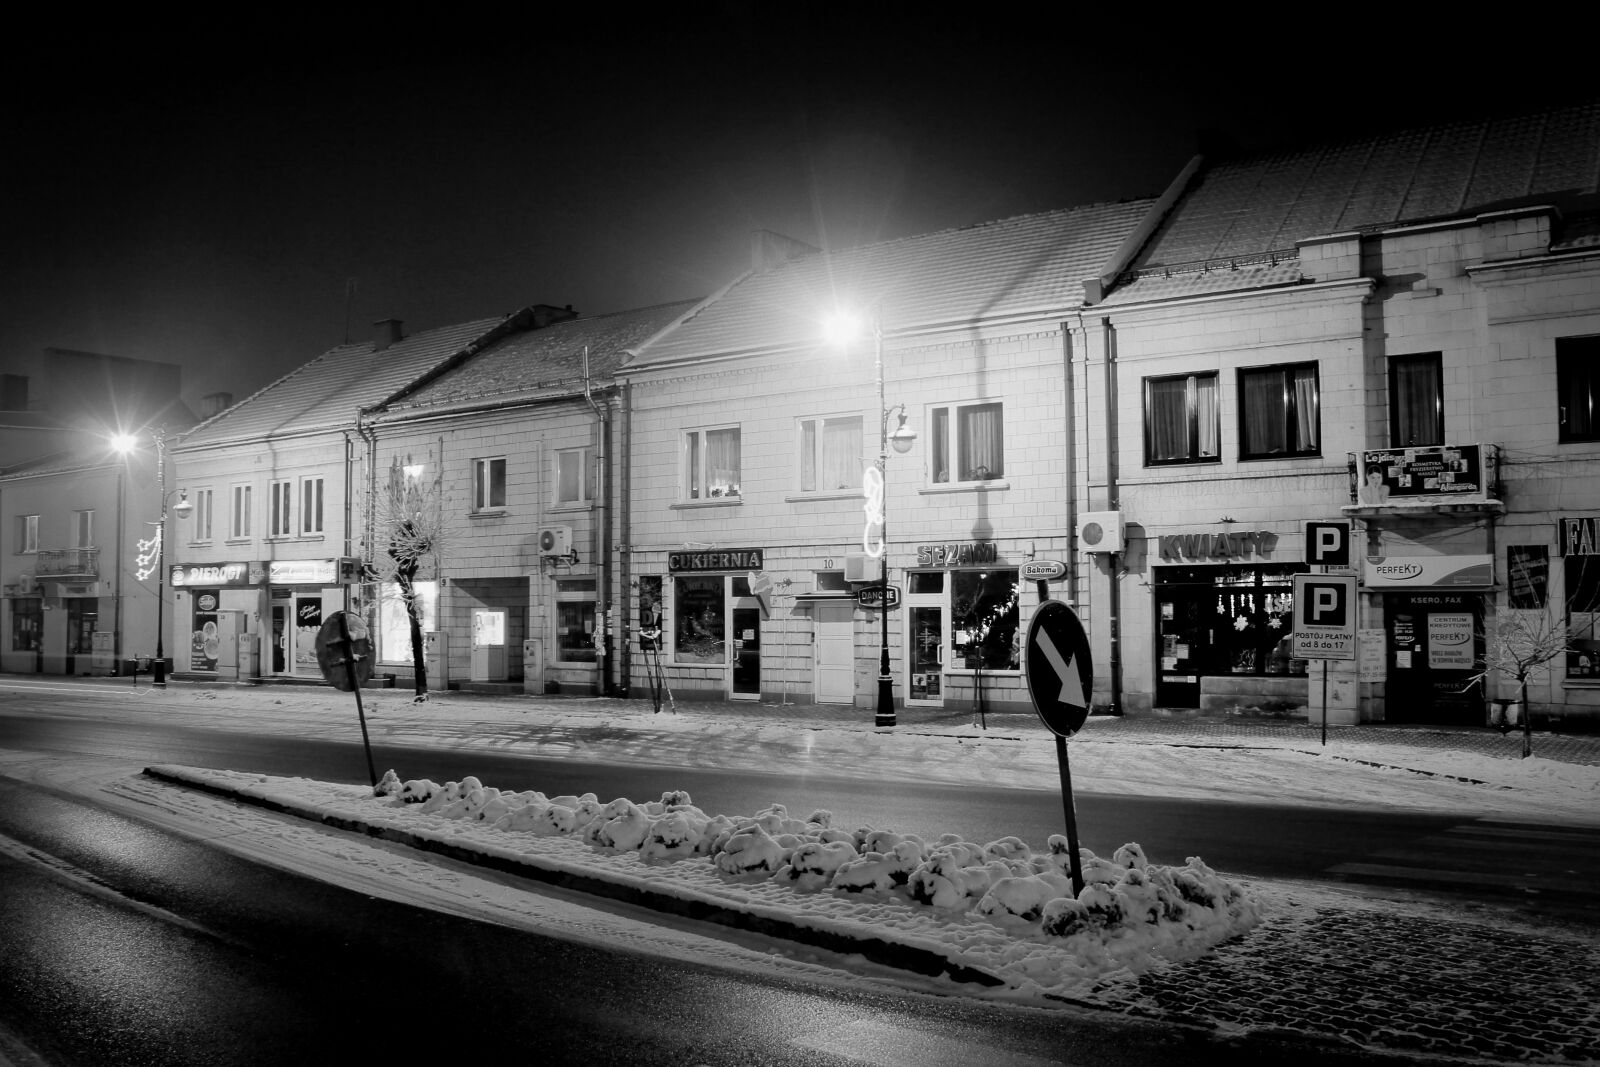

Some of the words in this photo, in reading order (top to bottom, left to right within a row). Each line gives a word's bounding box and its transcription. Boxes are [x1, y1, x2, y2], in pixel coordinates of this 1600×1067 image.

[1159, 531, 1271, 558] KWIATY
[1316, 527, 1340, 560] P
[669, 552, 760, 569] CUKIERNIA
[917, 543, 993, 564] SEZAM
[824, 559, 834, 569] 10
[1026, 566, 1057, 574] Bakoma
[190, 565, 242, 581] PIEROGI
[1313, 587, 1338, 620] P
[1295, 632, 1323, 640] POSTÓJ
[1325, 633, 1353, 641] PŁATNY
